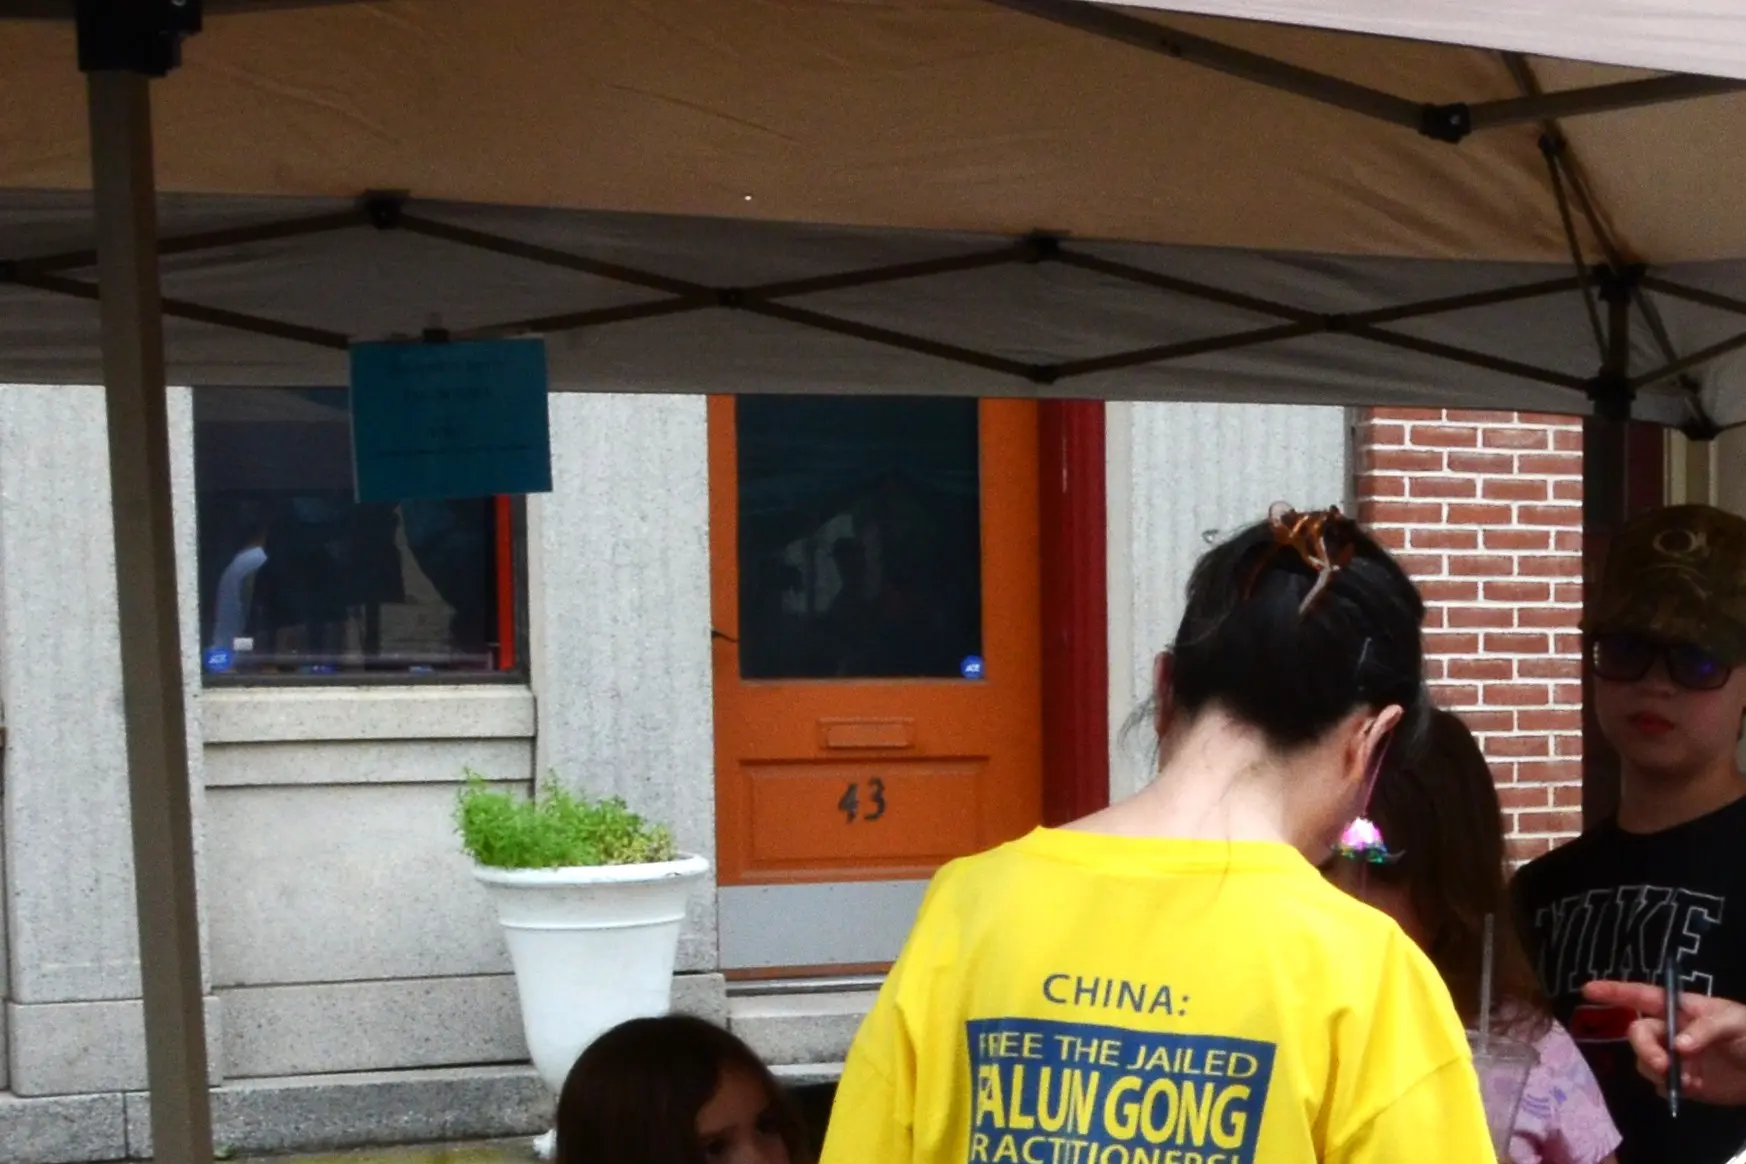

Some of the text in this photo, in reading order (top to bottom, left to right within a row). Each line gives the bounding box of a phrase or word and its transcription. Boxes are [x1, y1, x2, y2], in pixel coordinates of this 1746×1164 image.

[838, 776, 886, 823] 43
[1042, 972, 1190, 1016] CHINA:
[1054, 1034, 1122, 1067] THE
[1127, 1044, 1258, 1079] JAILED
[1103, 1075, 1251, 1150] GONG
